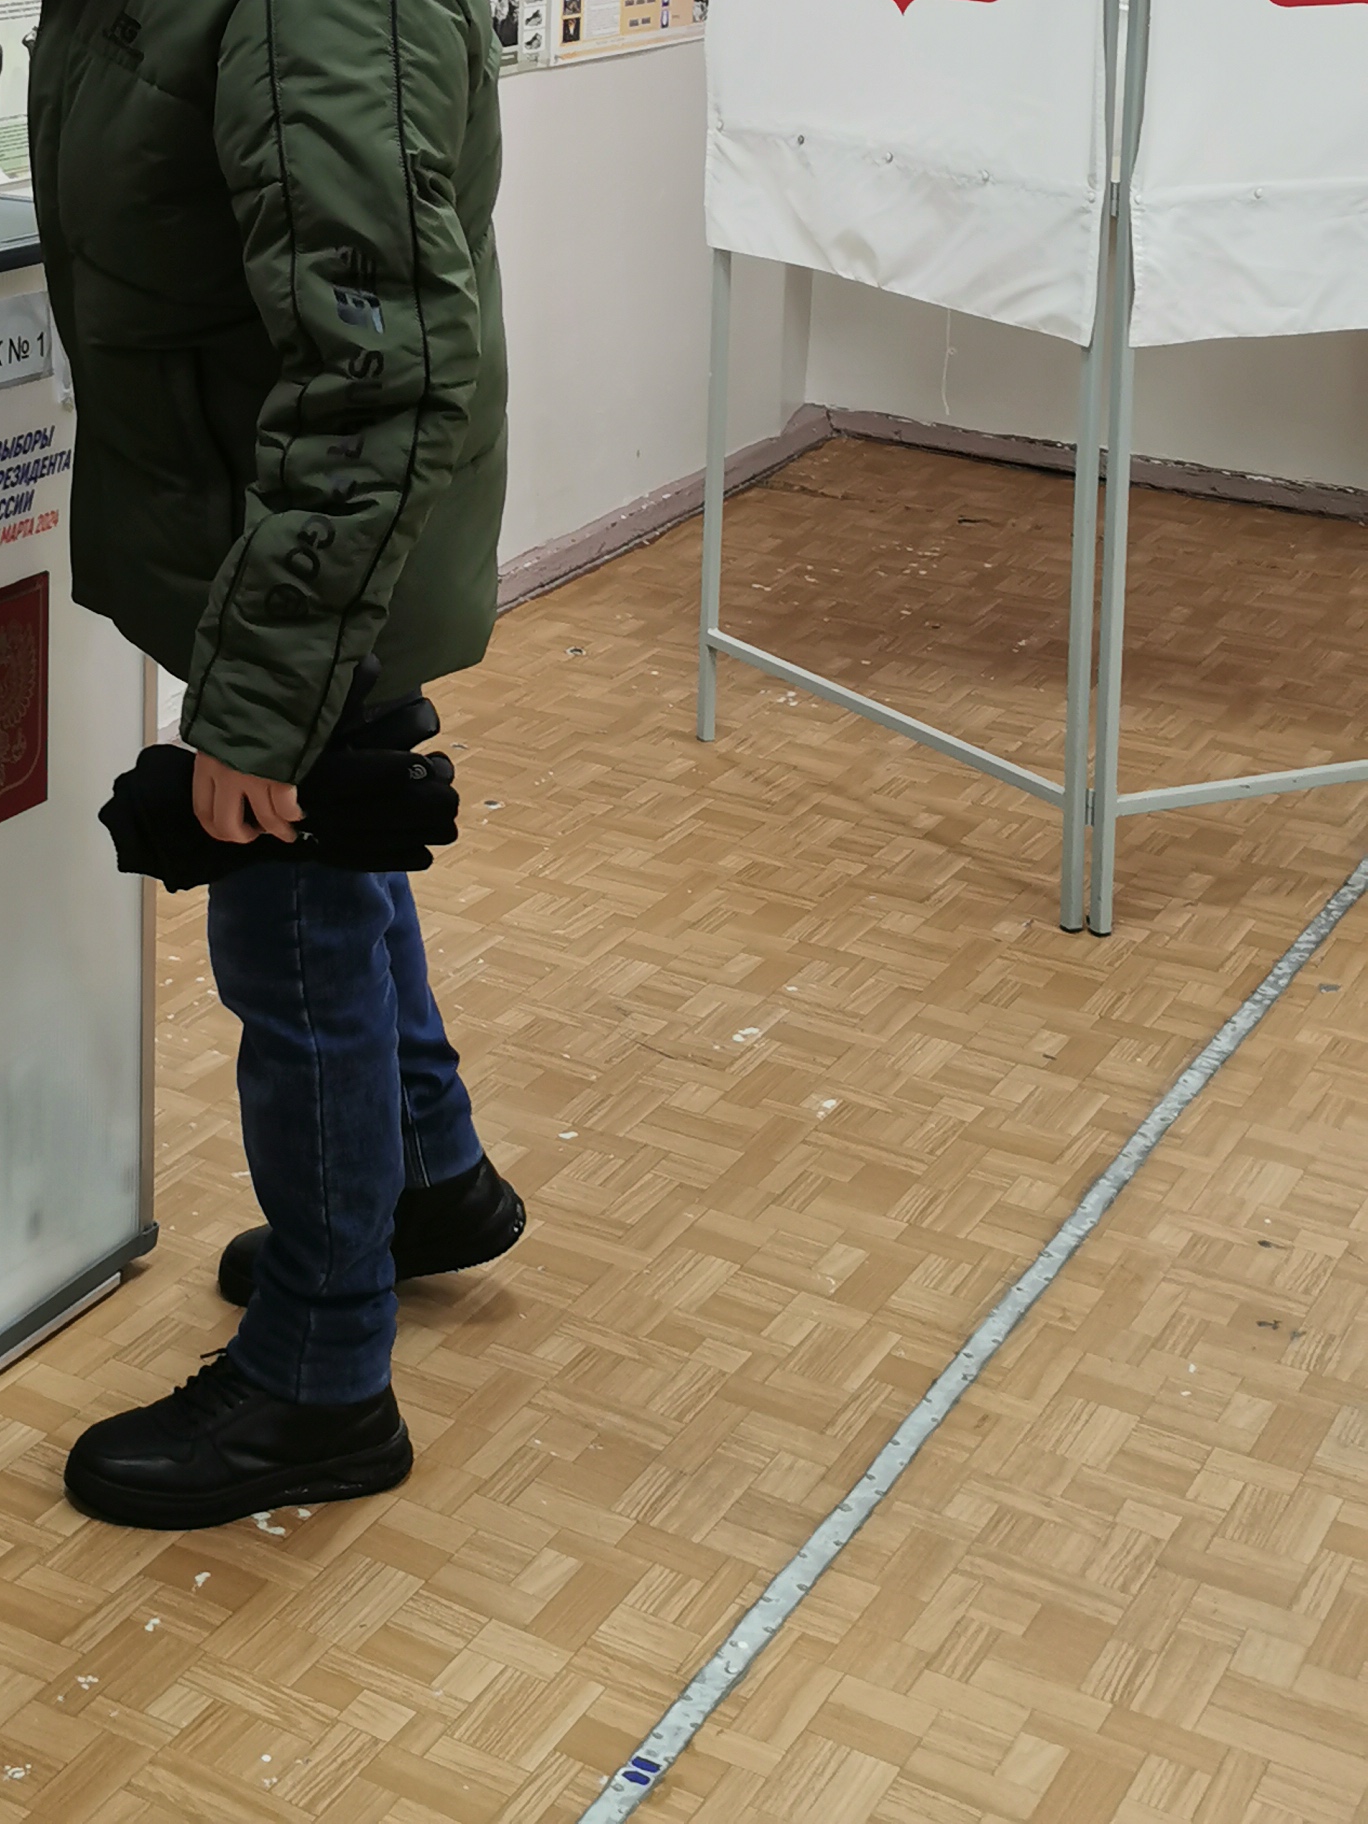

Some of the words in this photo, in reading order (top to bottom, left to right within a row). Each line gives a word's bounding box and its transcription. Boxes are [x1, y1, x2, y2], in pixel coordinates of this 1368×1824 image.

[8, 336, 29, 364] №
[37, 332, 44, 357] 1
[1, 516, 33, 545] МАРТА
[35, 509, 59, 534] 2024
